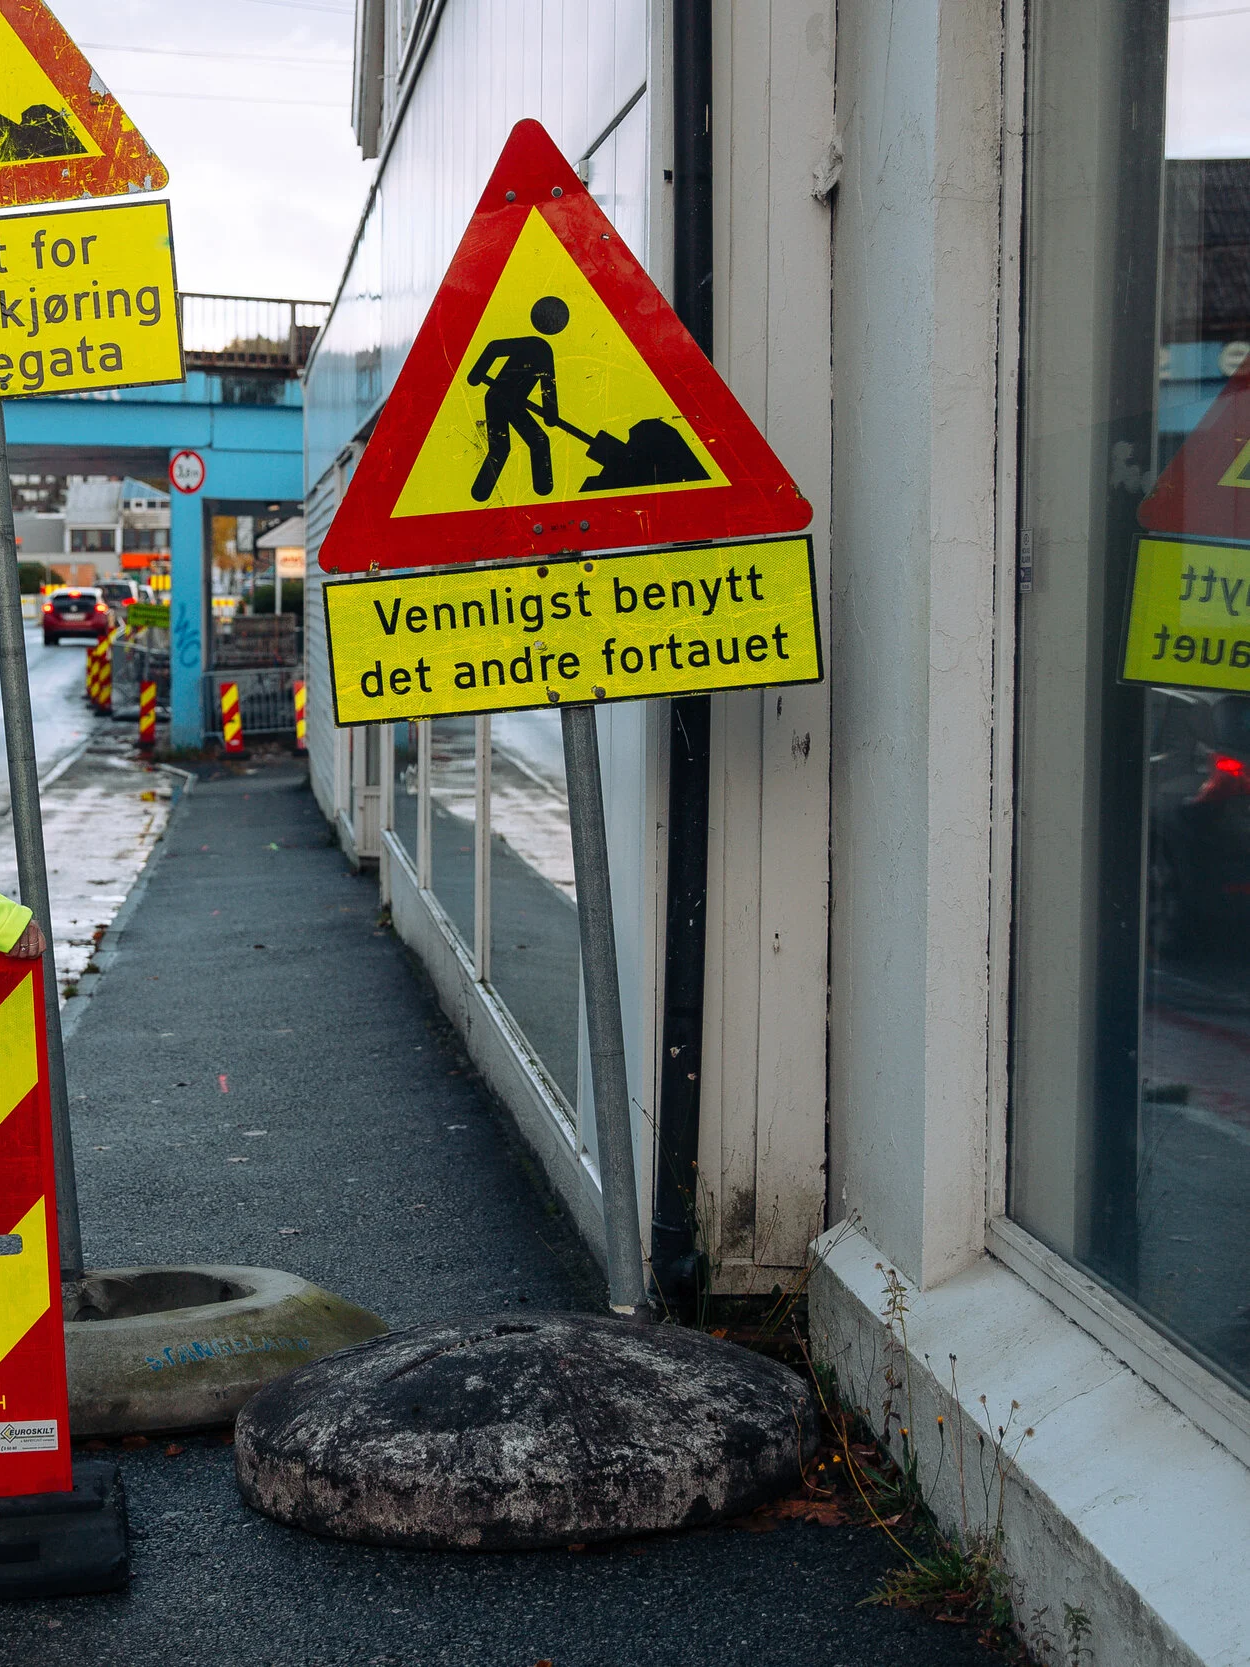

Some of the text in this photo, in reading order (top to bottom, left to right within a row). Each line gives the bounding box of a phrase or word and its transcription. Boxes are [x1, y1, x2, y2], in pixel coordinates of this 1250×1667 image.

[31, 229, 98, 270] for
[373, 564, 765, 636] Vennligst benytt
[361, 623, 790, 698] det andre fortauet
[9, 1427, 55, 1436] EUROSKILT
